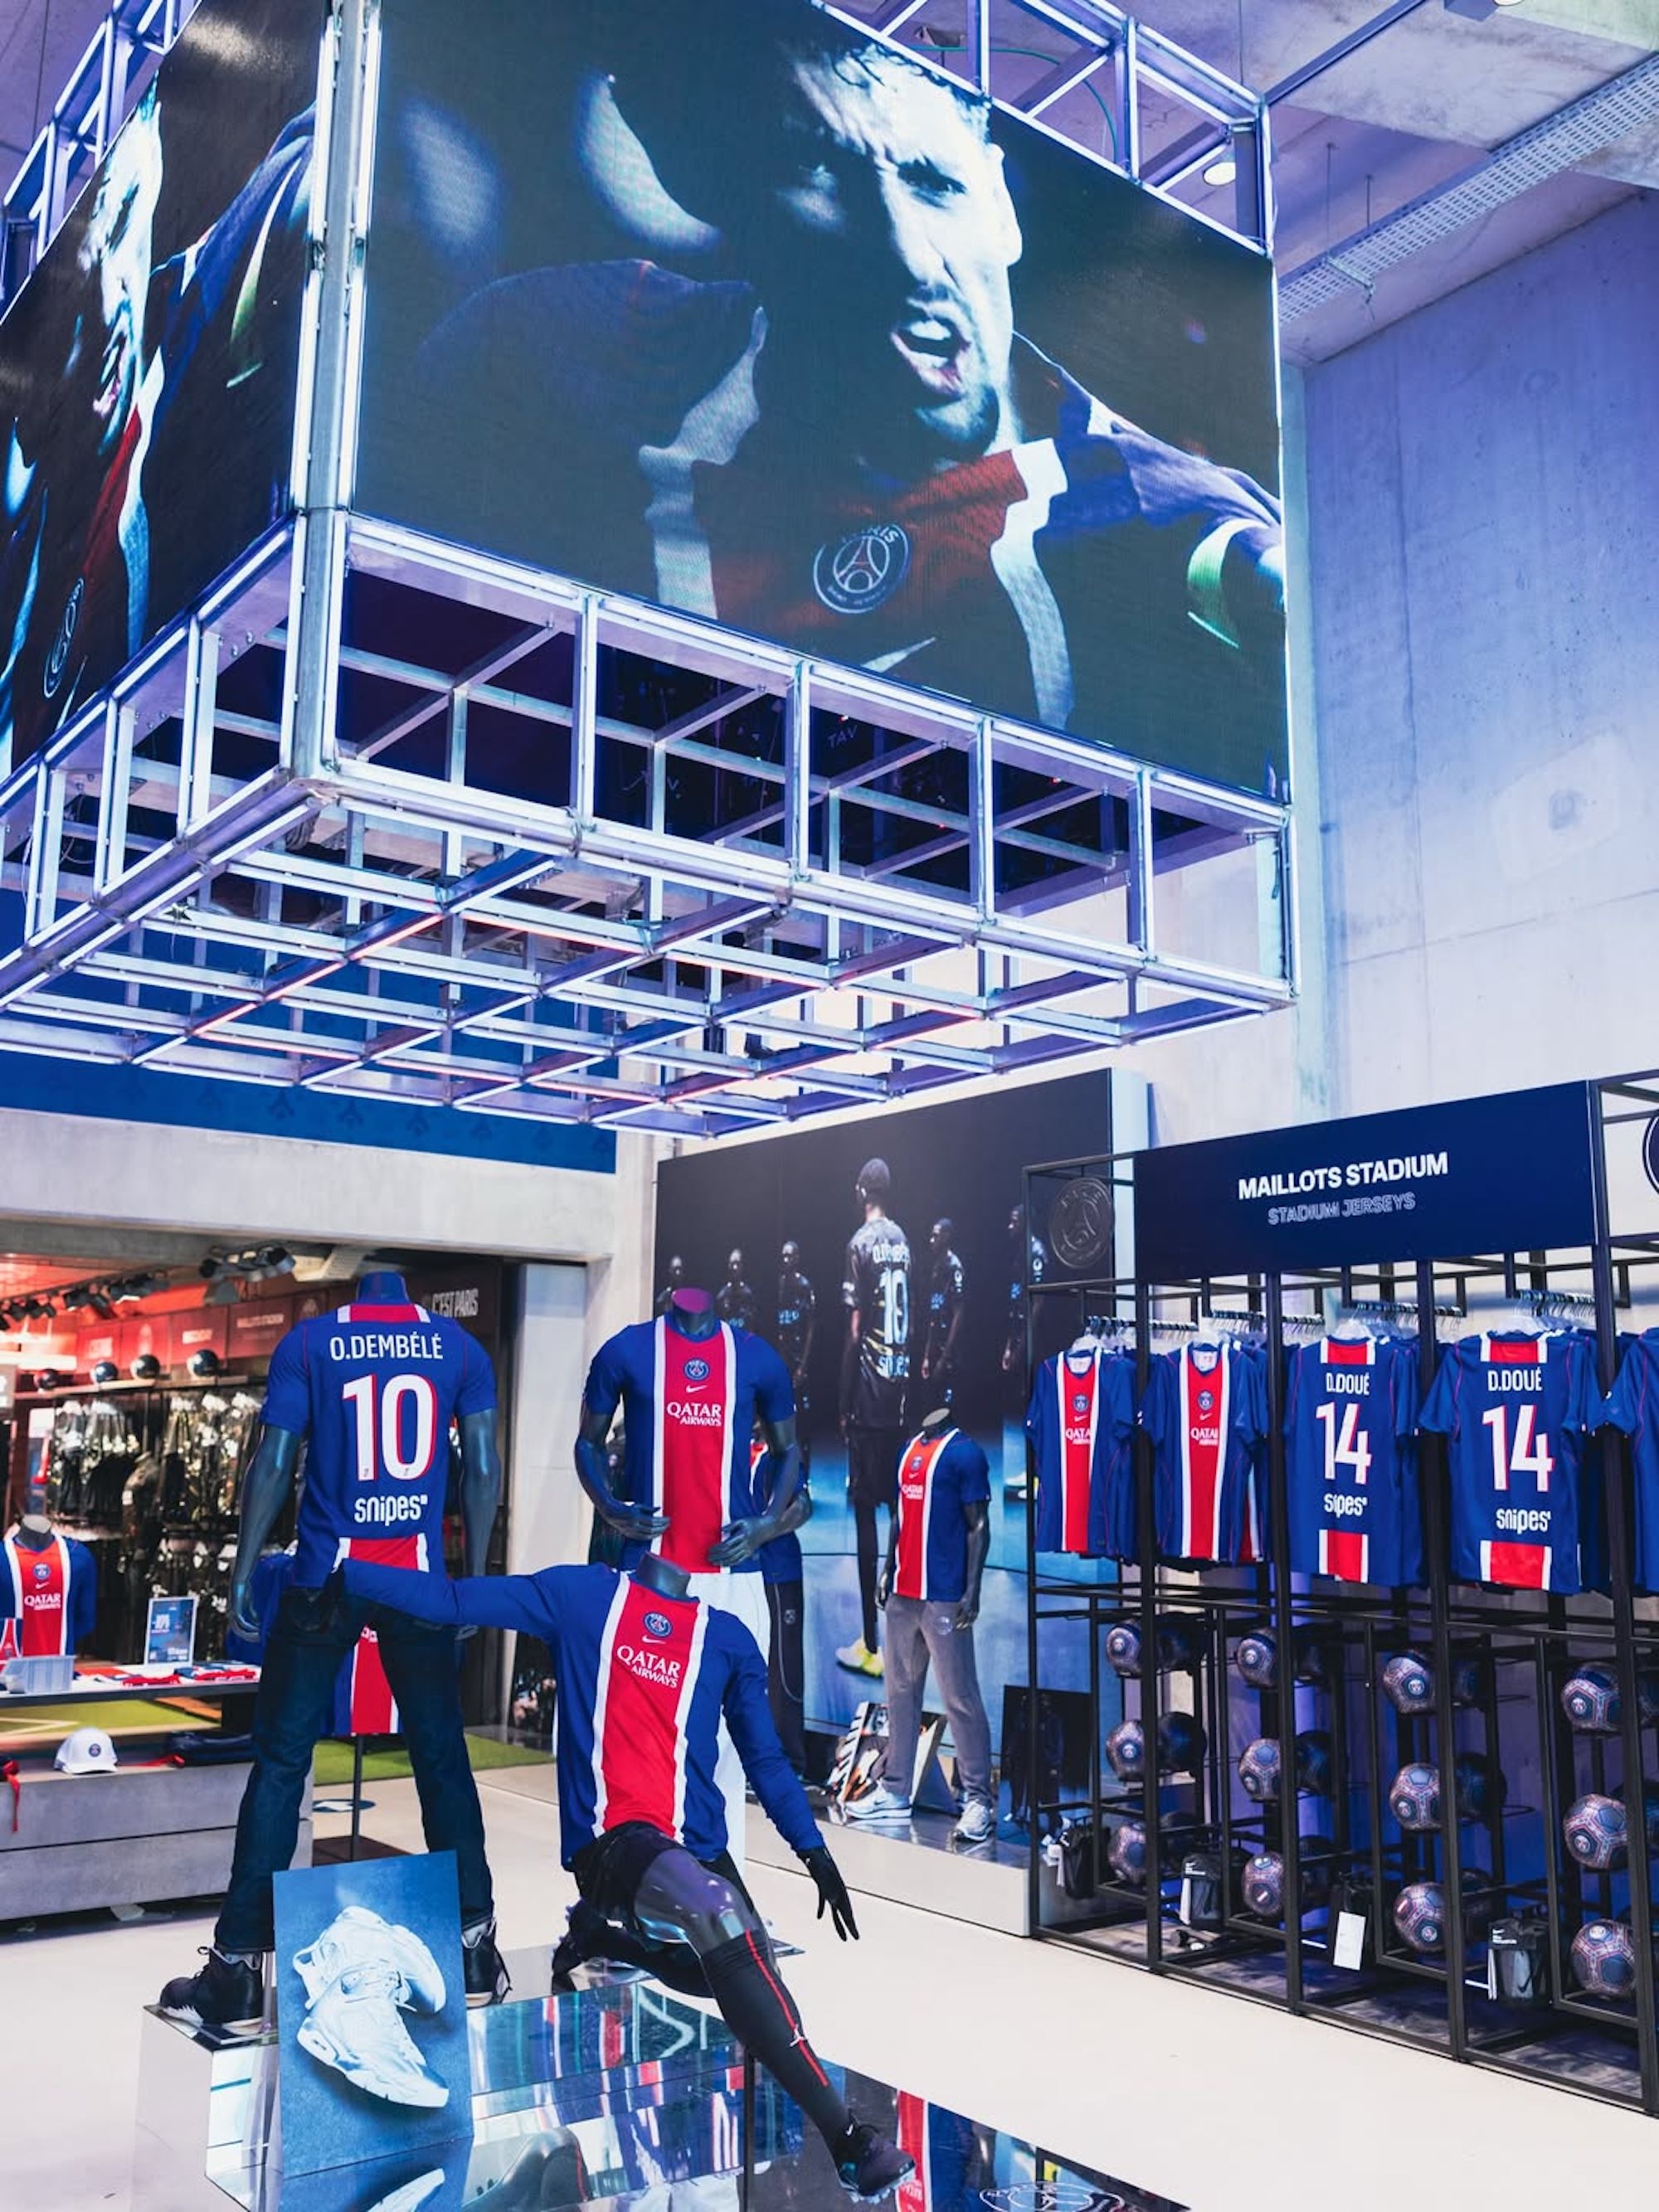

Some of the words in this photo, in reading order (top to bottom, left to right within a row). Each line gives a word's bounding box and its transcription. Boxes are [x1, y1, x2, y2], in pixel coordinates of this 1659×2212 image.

[1238, 1167, 1342, 1200] MAILLOTS
[1345, 1151, 1448, 1187] STADIUM
[1267, 1201, 1340, 1226] STADIUM
[1342, 1191, 1417, 1218] JERSEYS
[879, 1268, 909, 1344] 10
[329, 1330, 444, 1361] O.DEMBÉLÉ
[1487, 1367, 1543, 1392] D.DOUÉ
[666, 1401, 722, 1419] QATAR
[679, 1415, 722, 1427] AIRWAYS
[343, 1373, 438, 1482] 10
[1065, 1427, 1091, 1441] QATA
[1316, 1402, 1373, 1485] 14
[1482, 1404, 1556, 1493] 14
[354, 1495, 423, 1526] snipes
[1496, 1508, 1548, 1534] snipes
[23, 1593, 61, 1607] QATAR
[616, 1645, 682, 1679] QATAR
[630, 1665, 679, 1689] AIRWAYS
